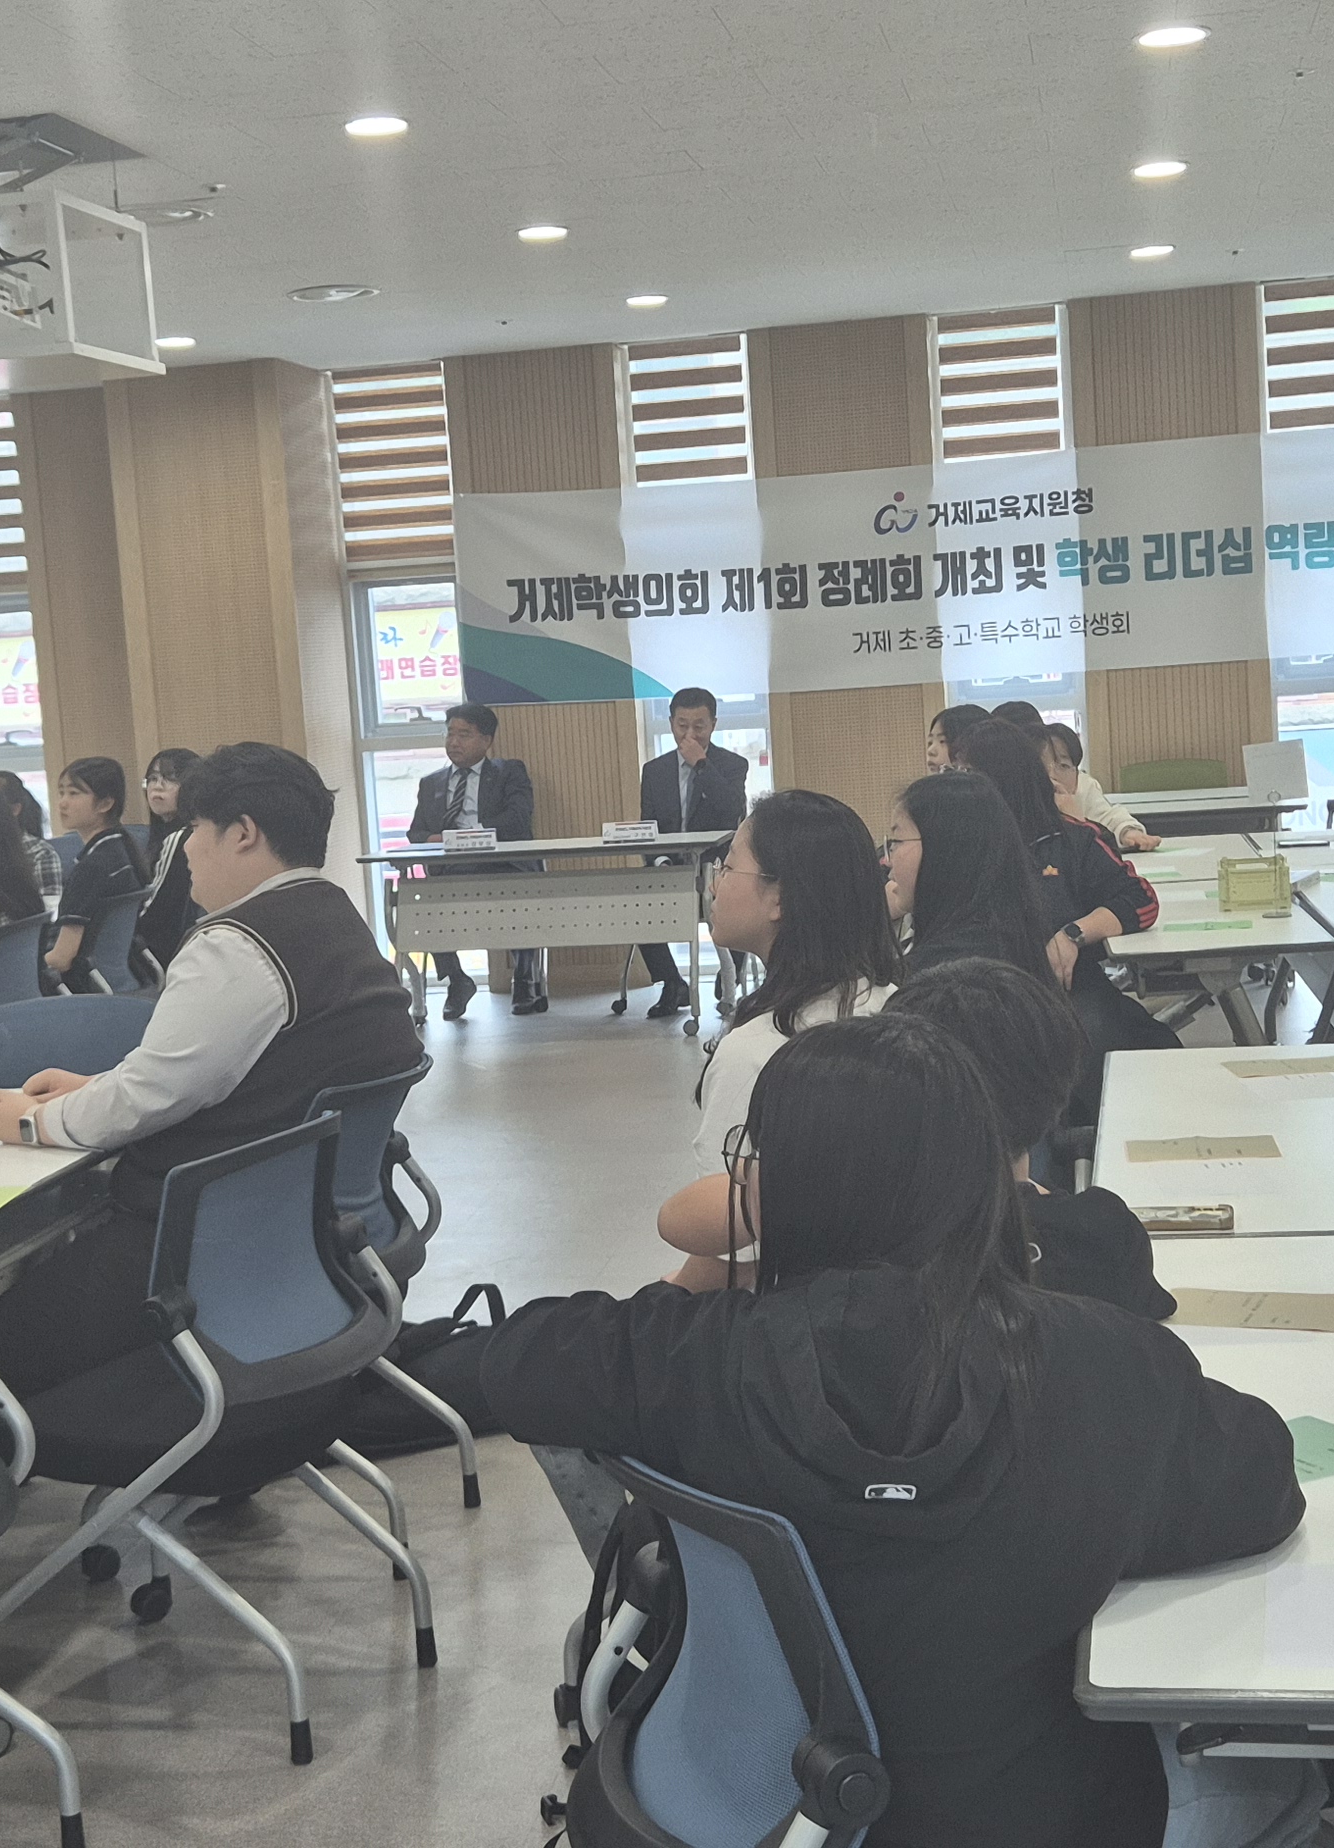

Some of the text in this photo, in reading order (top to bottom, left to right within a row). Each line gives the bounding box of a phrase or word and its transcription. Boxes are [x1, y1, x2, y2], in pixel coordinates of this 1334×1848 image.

[927, 487, 1094, 527] 거제교육지원청
[506, 568, 710, 624] 거제학생의회
[720, 566, 808, 614] 제1회
[818, 553, 923, 608] 정례회
[933, 546, 1003, 598] 개최
[1011, 544, 1047, 591] 및
[1054, 535, 1131, 587] 학생
[1142, 526, 1253, 582] 리더십
[851, 629, 892, 655] 거제
[1068, 610, 1131, 638] 학생회
